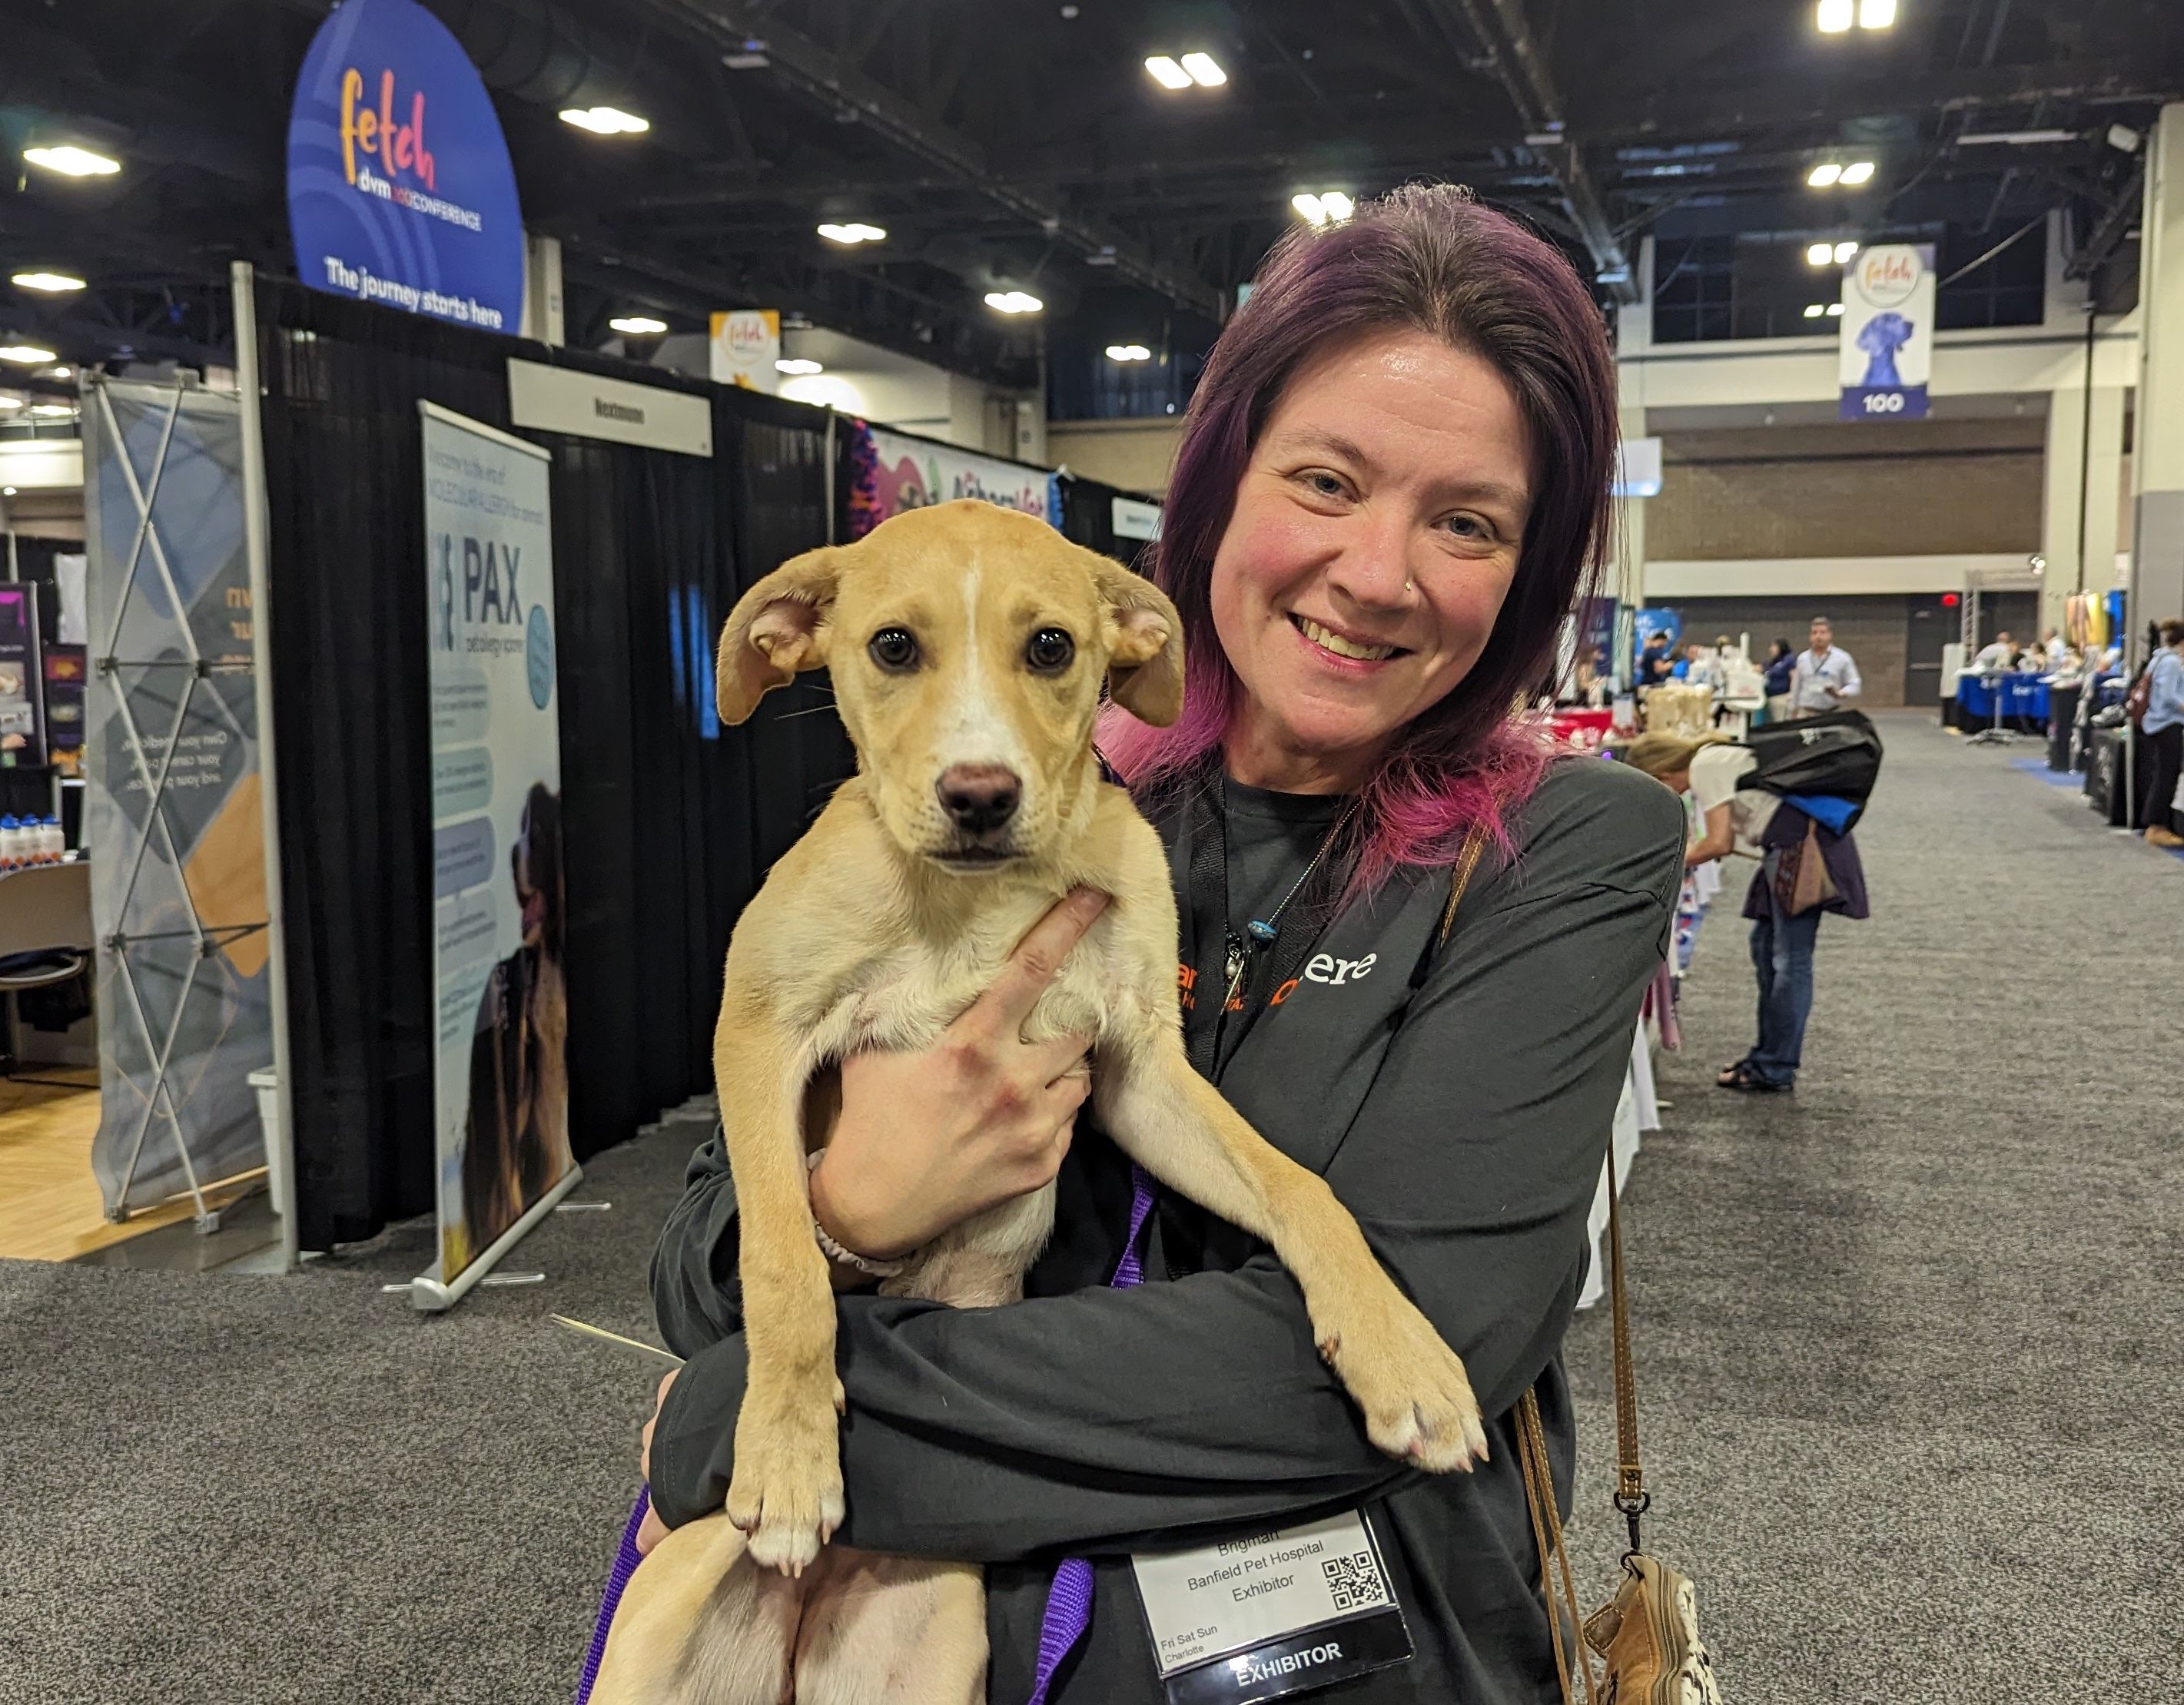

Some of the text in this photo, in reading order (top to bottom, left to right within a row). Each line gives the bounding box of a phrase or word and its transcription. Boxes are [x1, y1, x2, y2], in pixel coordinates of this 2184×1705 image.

[340, 68, 435, 191] fetch
[323, 254, 503, 329] The journey starts here
[1863, 393, 1904, 413] 100
[463, 536, 523, 626] PAX
[1217, 1530, 1280, 1557] Brigman
[1187, 1540, 1324, 1591] Banfield Pet Hospital
[1232, 1574, 1294, 1602] Exhibitor
[1160, 1624, 1218, 1651] Fri Sat Sun
[1164, 1644, 1205, 1664] Charlotte
[1234, 1641, 1343, 1687] EXHIBITOR
